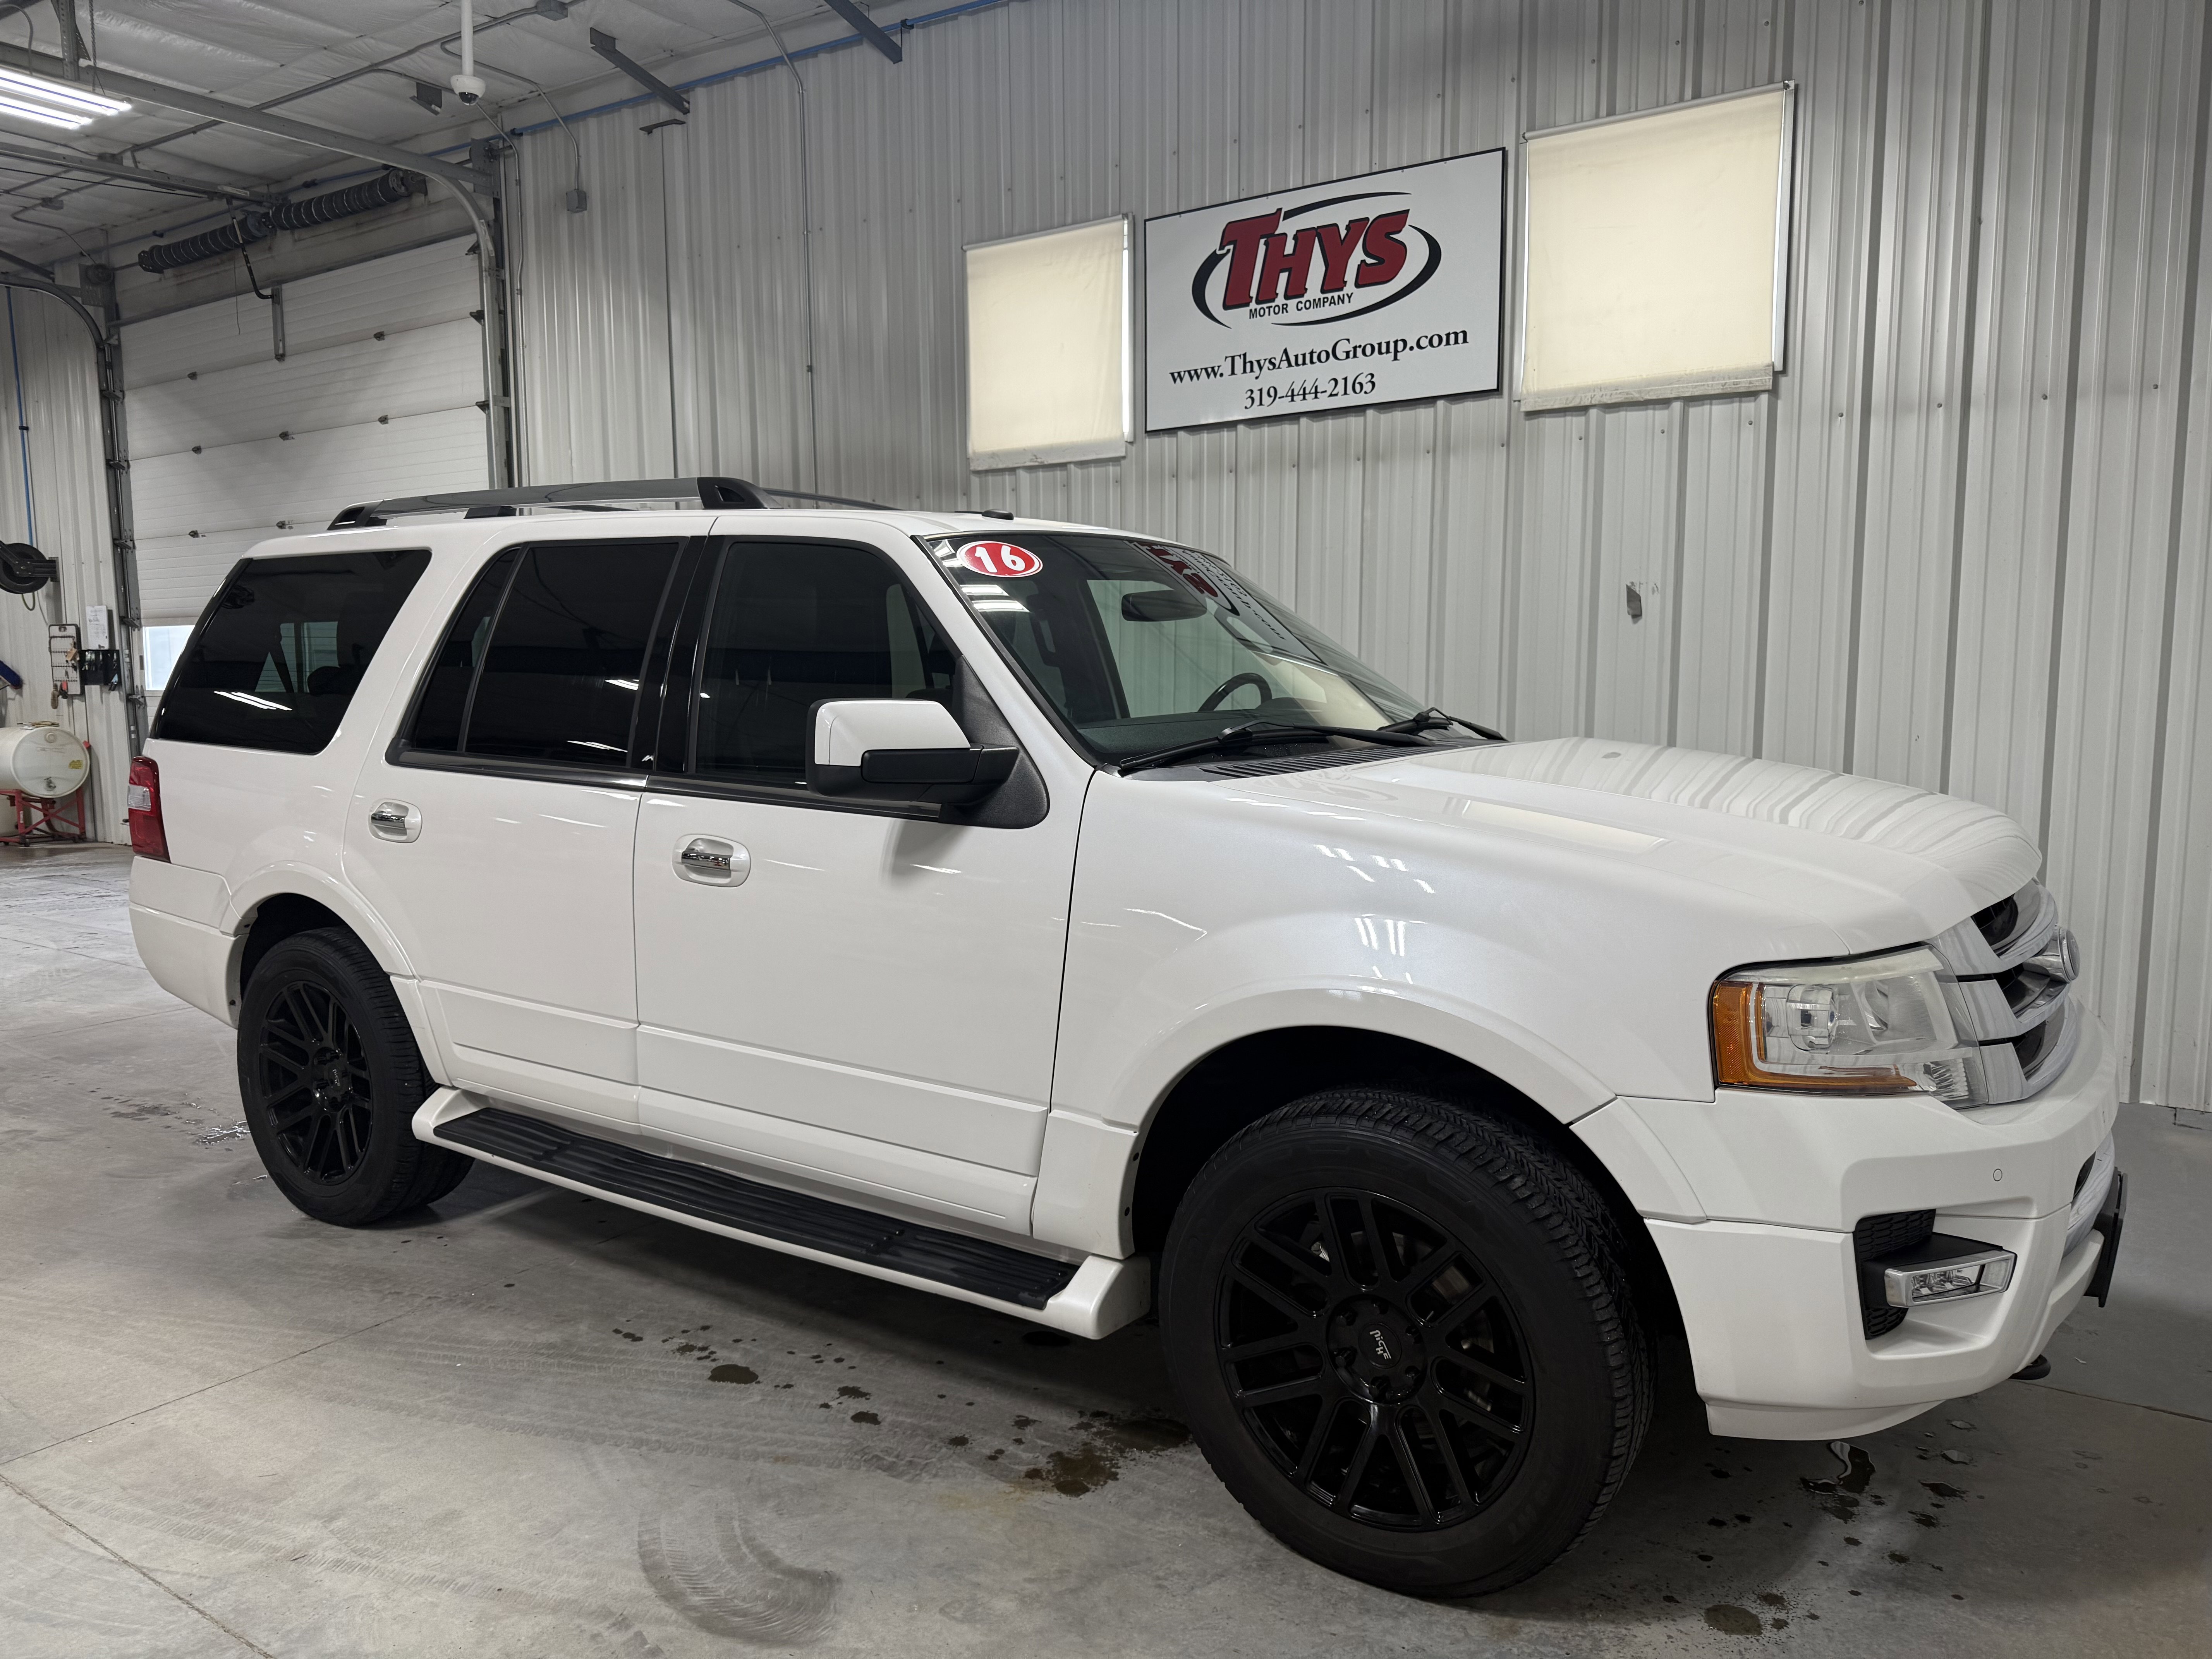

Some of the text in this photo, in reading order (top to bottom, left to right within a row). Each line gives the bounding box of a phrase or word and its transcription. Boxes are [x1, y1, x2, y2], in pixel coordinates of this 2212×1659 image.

[1218, 207, 1410, 311] THYS
[1249, 292, 1354, 319] MOTOR COMPANY
[1169, 330, 1469, 384] www.ThysAutoGroup.com
[1244, 373, 1376, 410] 319-444-2163
[975, 545, 1025, 573] 16
